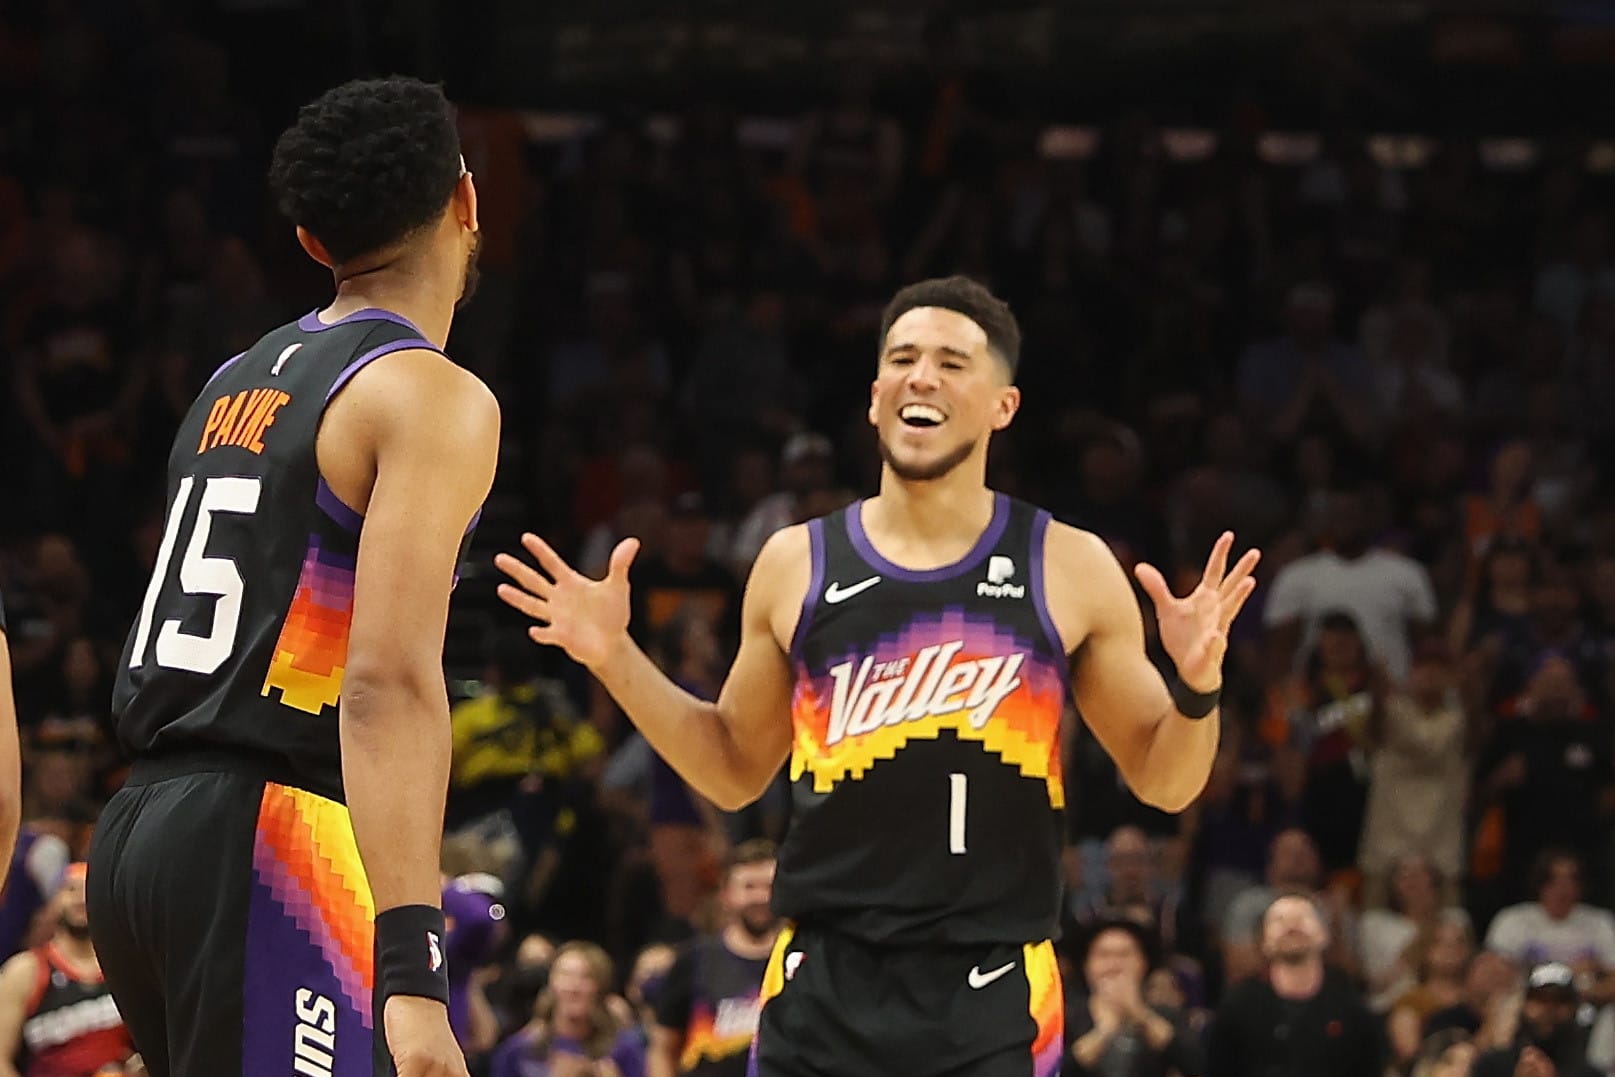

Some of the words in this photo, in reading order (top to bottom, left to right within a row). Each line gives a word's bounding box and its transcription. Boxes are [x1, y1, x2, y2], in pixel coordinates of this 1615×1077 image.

[196, 388, 292, 456] PAYNE
[128, 475, 262, 675] 15
[976, 581, 1026, 600] PayPal
[825, 639, 1025, 747] Valley
[949, 773, 968, 855] 1
